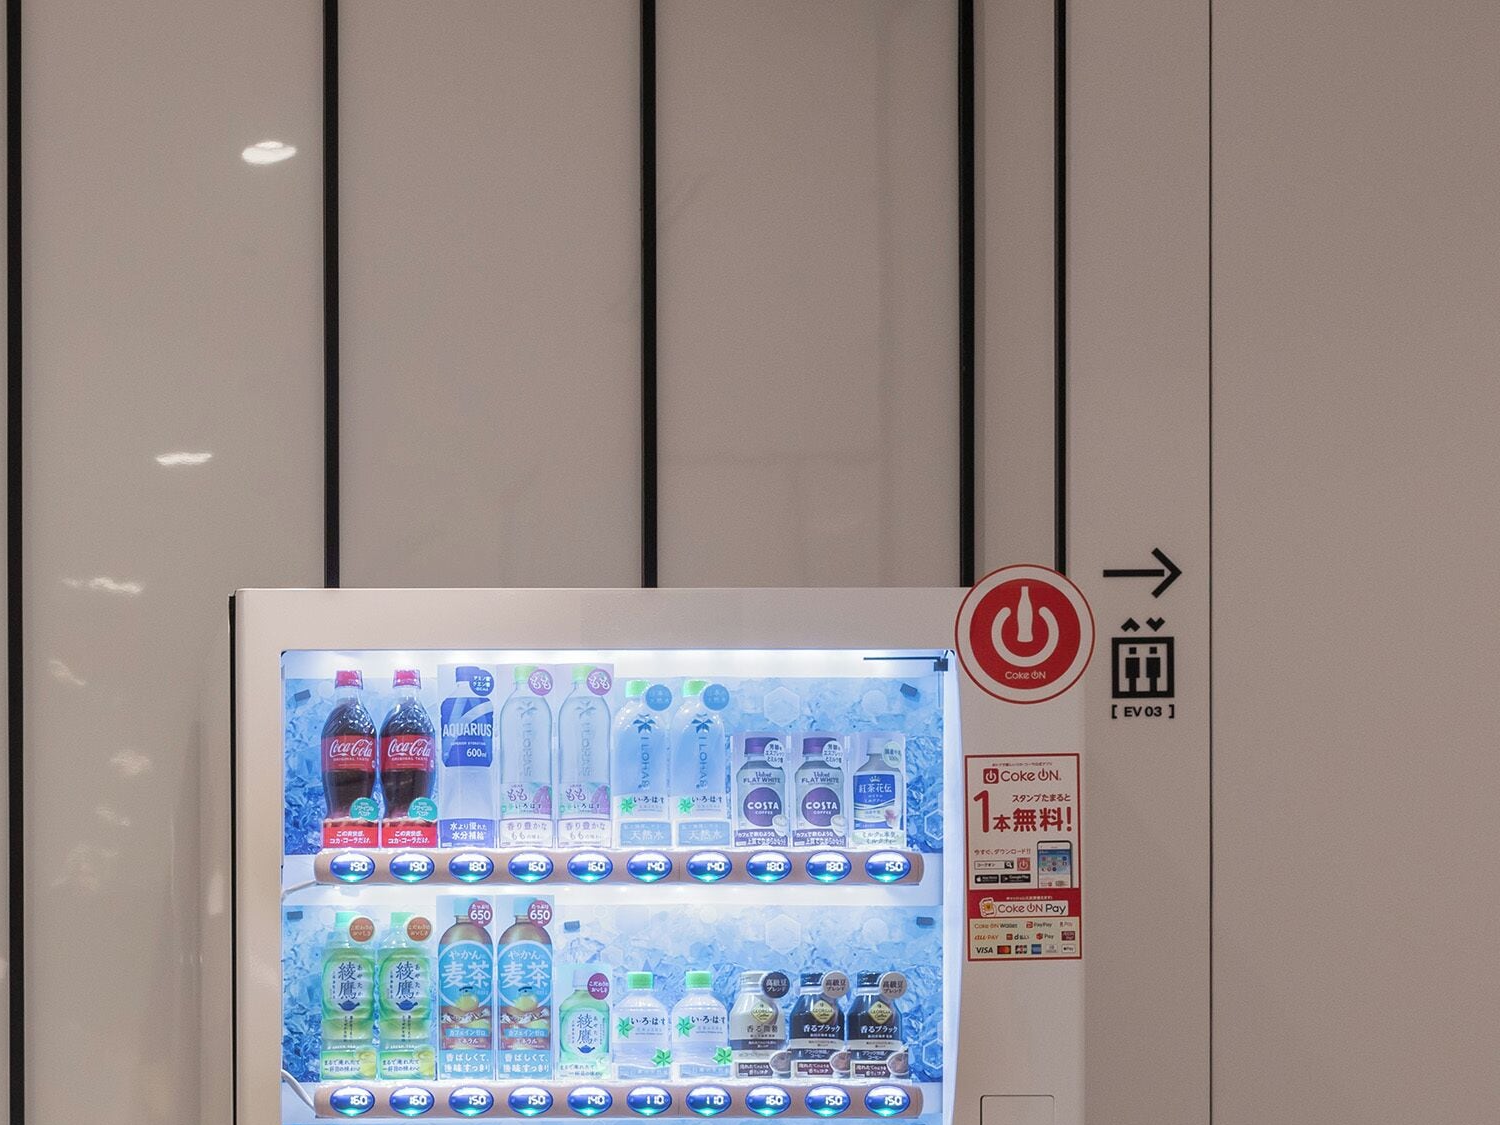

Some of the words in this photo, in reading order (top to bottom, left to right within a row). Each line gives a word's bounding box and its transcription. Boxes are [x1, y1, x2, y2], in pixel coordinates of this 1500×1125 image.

[1005, 671, 1029, 680] Coke
[1124, 707, 1142, 717] EV
[1145, 707, 1162, 717] 03
[442, 723, 493, 738] AQUARIUS
[329, 738, 373, 758] Coca-Cola
[387, 738, 431, 758] Coca-Cola
[1001, 770, 1035, 782] Coke
[858, 784, 893, 793] 紅茶花伝
[1012, 794, 1071, 803] スタンプたまると
[747, 801, 779, 810] COSTA
[805, 801, 838, 810] COSTA
[973, 790, 1072, 833] 1本無料!
[350, 861, 368, 872] 190
[409, 861, 427, 872] 190
[469, 861, 487, 872] 180
[528, 861, 546, 872] 160
[588, 861, 606, 872] 160
[647, 861, 665, 872] 140
[707, 861, 725, 872] 140
[766, 861, 784, 872] 180
[826, 861, 844, 872] 180
[885, 861, 903, 872] 150
[998, 904, 1025, 913] Coke
[1045, 904, 1066, 914] Pay
[470, 910, 491, 921] 650
[530, 910, 550, 921] 650
[442, 961, 492, 988] 麦茶
[501, 961, 550, 988] 麦茶
[337, 961, 358, 1000] 綾鷹
[395, 961, 416, 1000] 綾鷹
[577, 1013, 593, 1045] 綾鷹
[803, 1024, 841, 1033] 香るブラック
[860, 1025, 898, 1034] 香るブラック
[350, 1095, 368, 1106] 160
[409, 1095, 427, 1106] 160
[469, 1095, 487, 1106] 150
[528, 1095, 546, 1106] 150
[588, 1095, 606, 1106] 140
[647, 1095, 665, 1106] 110
[707, 1095, 725, 1106] 110
[766, 1095, 784, 1106] 160
[826, 1095, 844, 1106] 150
[885, 1095, 903, 1106] 150
